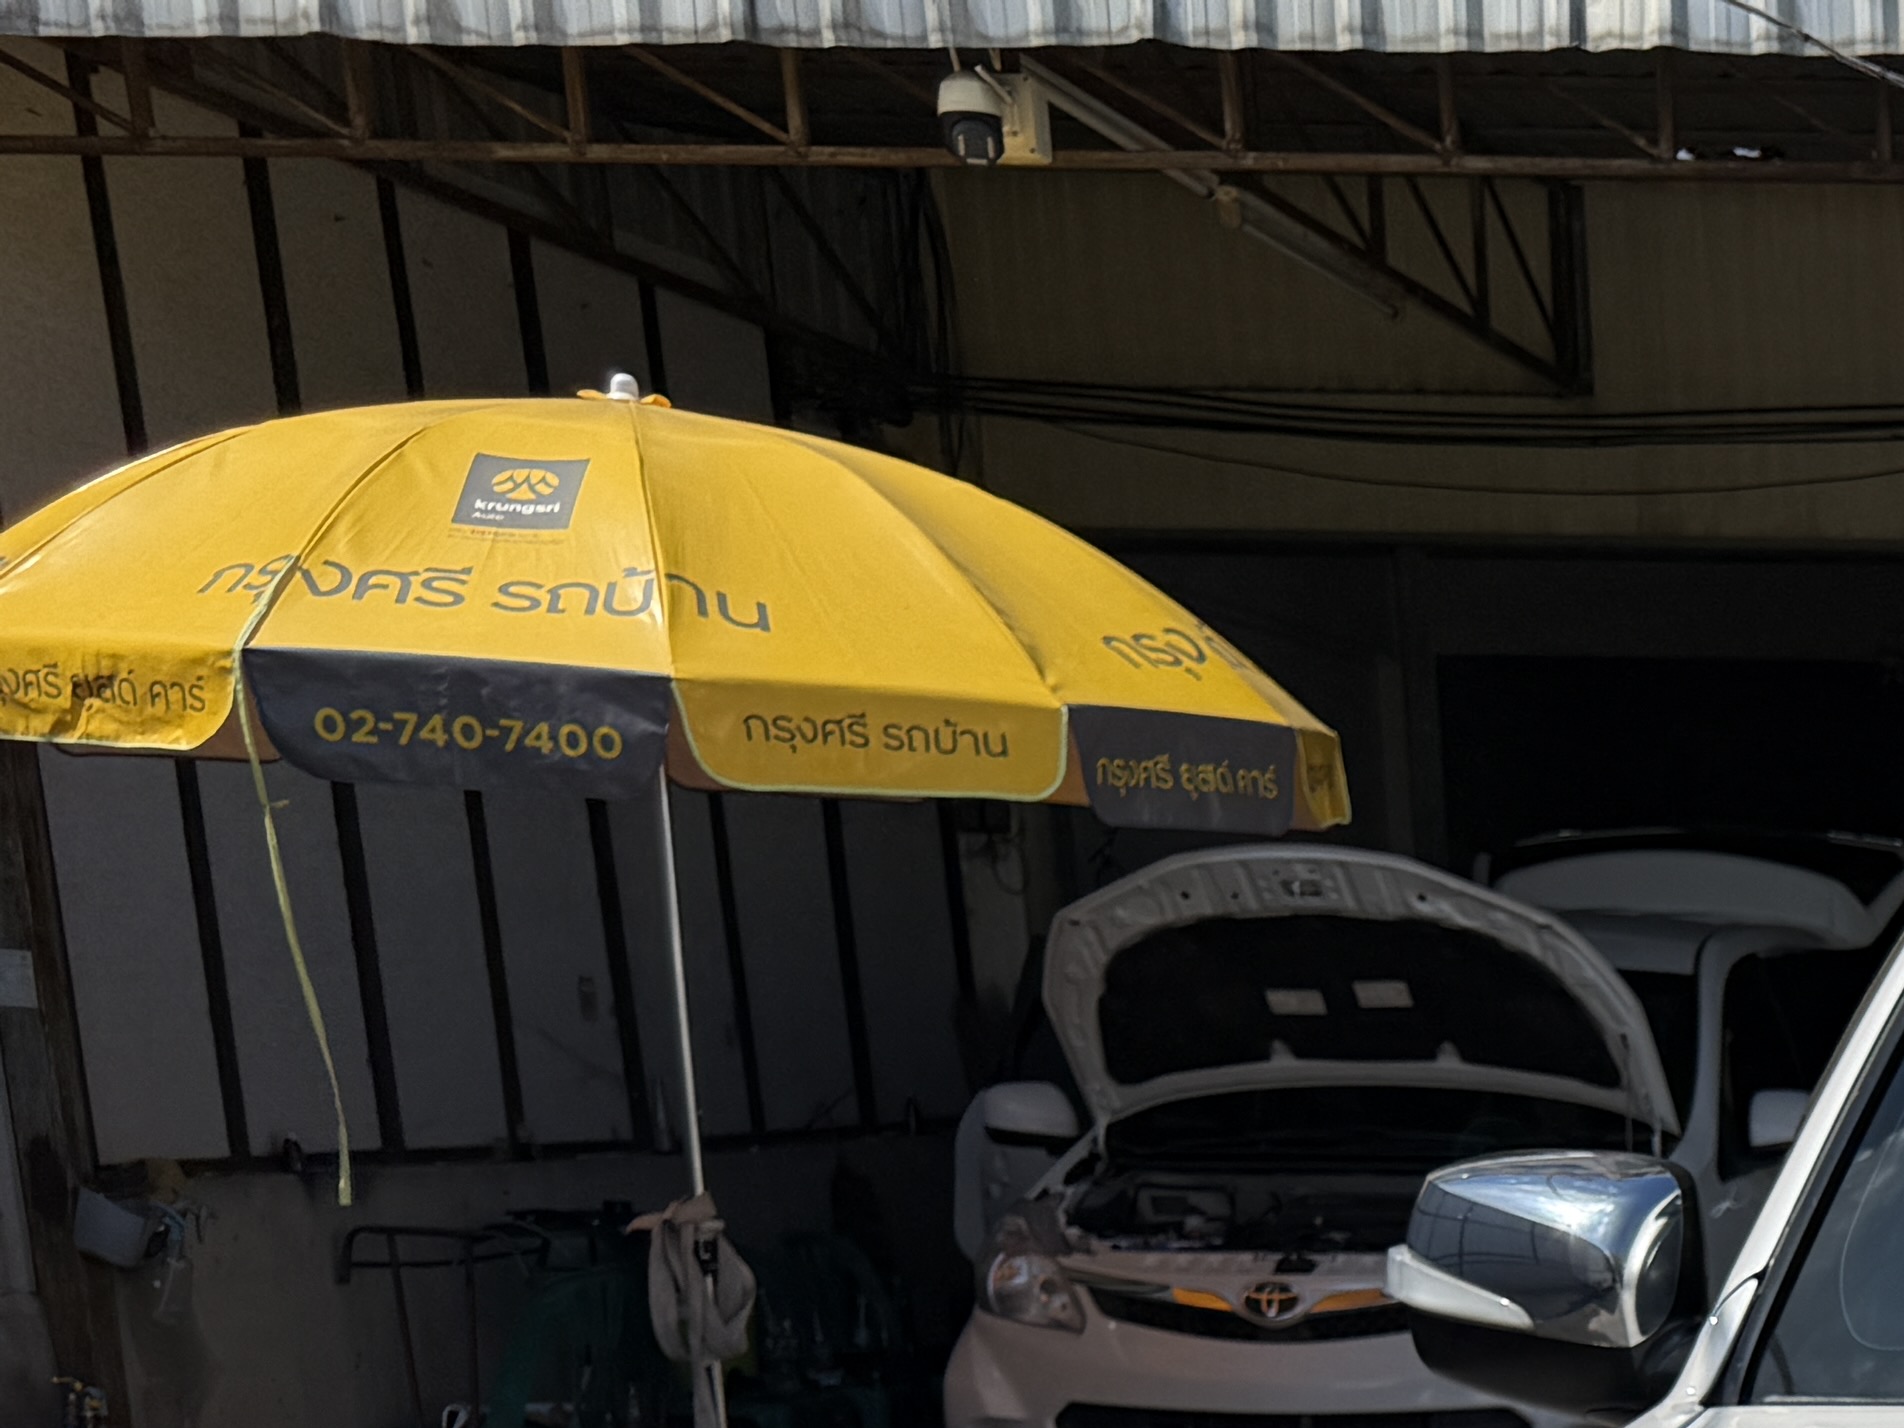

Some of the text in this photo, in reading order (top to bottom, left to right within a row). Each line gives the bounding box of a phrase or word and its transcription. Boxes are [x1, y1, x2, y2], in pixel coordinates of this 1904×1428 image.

[474, 499, 561, 515] krungsri
[490, 566, 770, 632] รถบ้าน
[149, 675, 206, 712] คาร์
[314, 707, 623, 760] 02-740-7400
[742, 712, 1009, 758] กรุงศรี รถบ้าน
[1096, 753, 1174, 797] กรุงศรี
